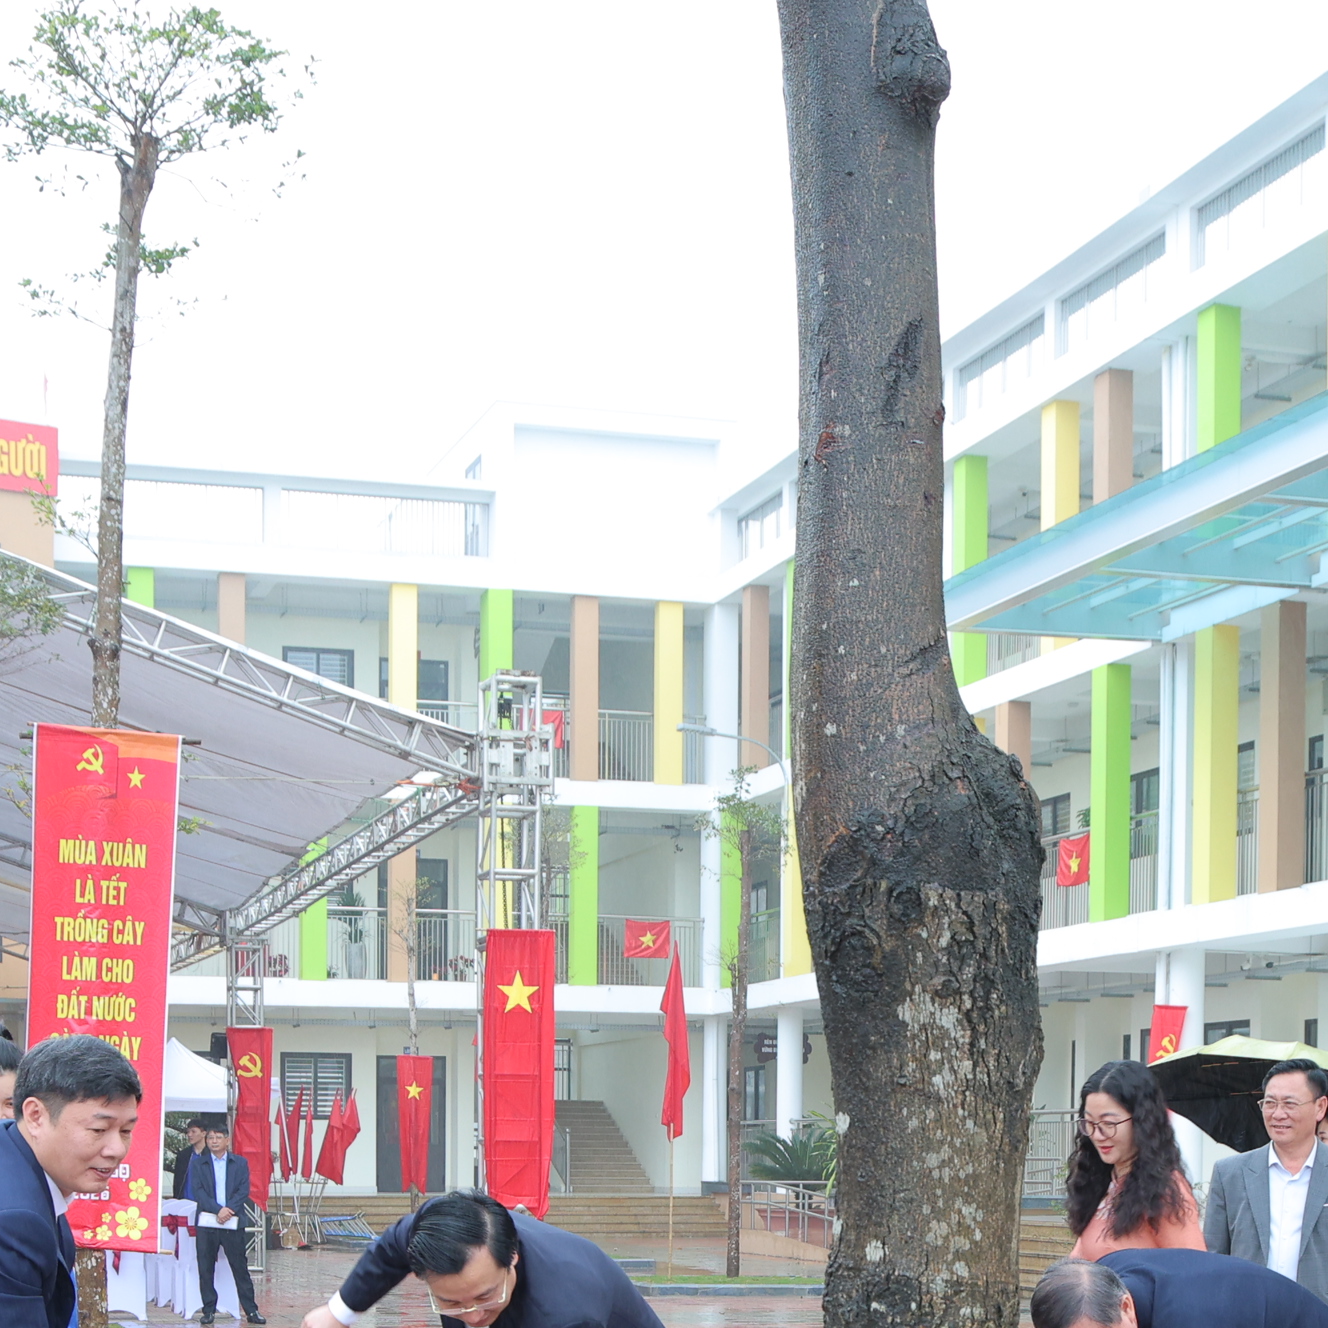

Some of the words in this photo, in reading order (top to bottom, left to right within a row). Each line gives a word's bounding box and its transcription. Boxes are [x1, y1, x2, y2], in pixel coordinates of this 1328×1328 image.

[58, 834, 97, 865] MÙA
[101, 838, 147, 869] XUÂN
[75, 873, 96, 904] LÀ
[100, 873, 128, 906] TẾT
[54, 909, 109, 943] TRỒNG
[112, 915, 145, 946] CÂY
[62, 951, 97, 981] LÀM
[102, 957, 134, 984] CHO
[56, 986, 88, 1019] ĐẤT
[92, 992, 137, 1022] NƯỚC
